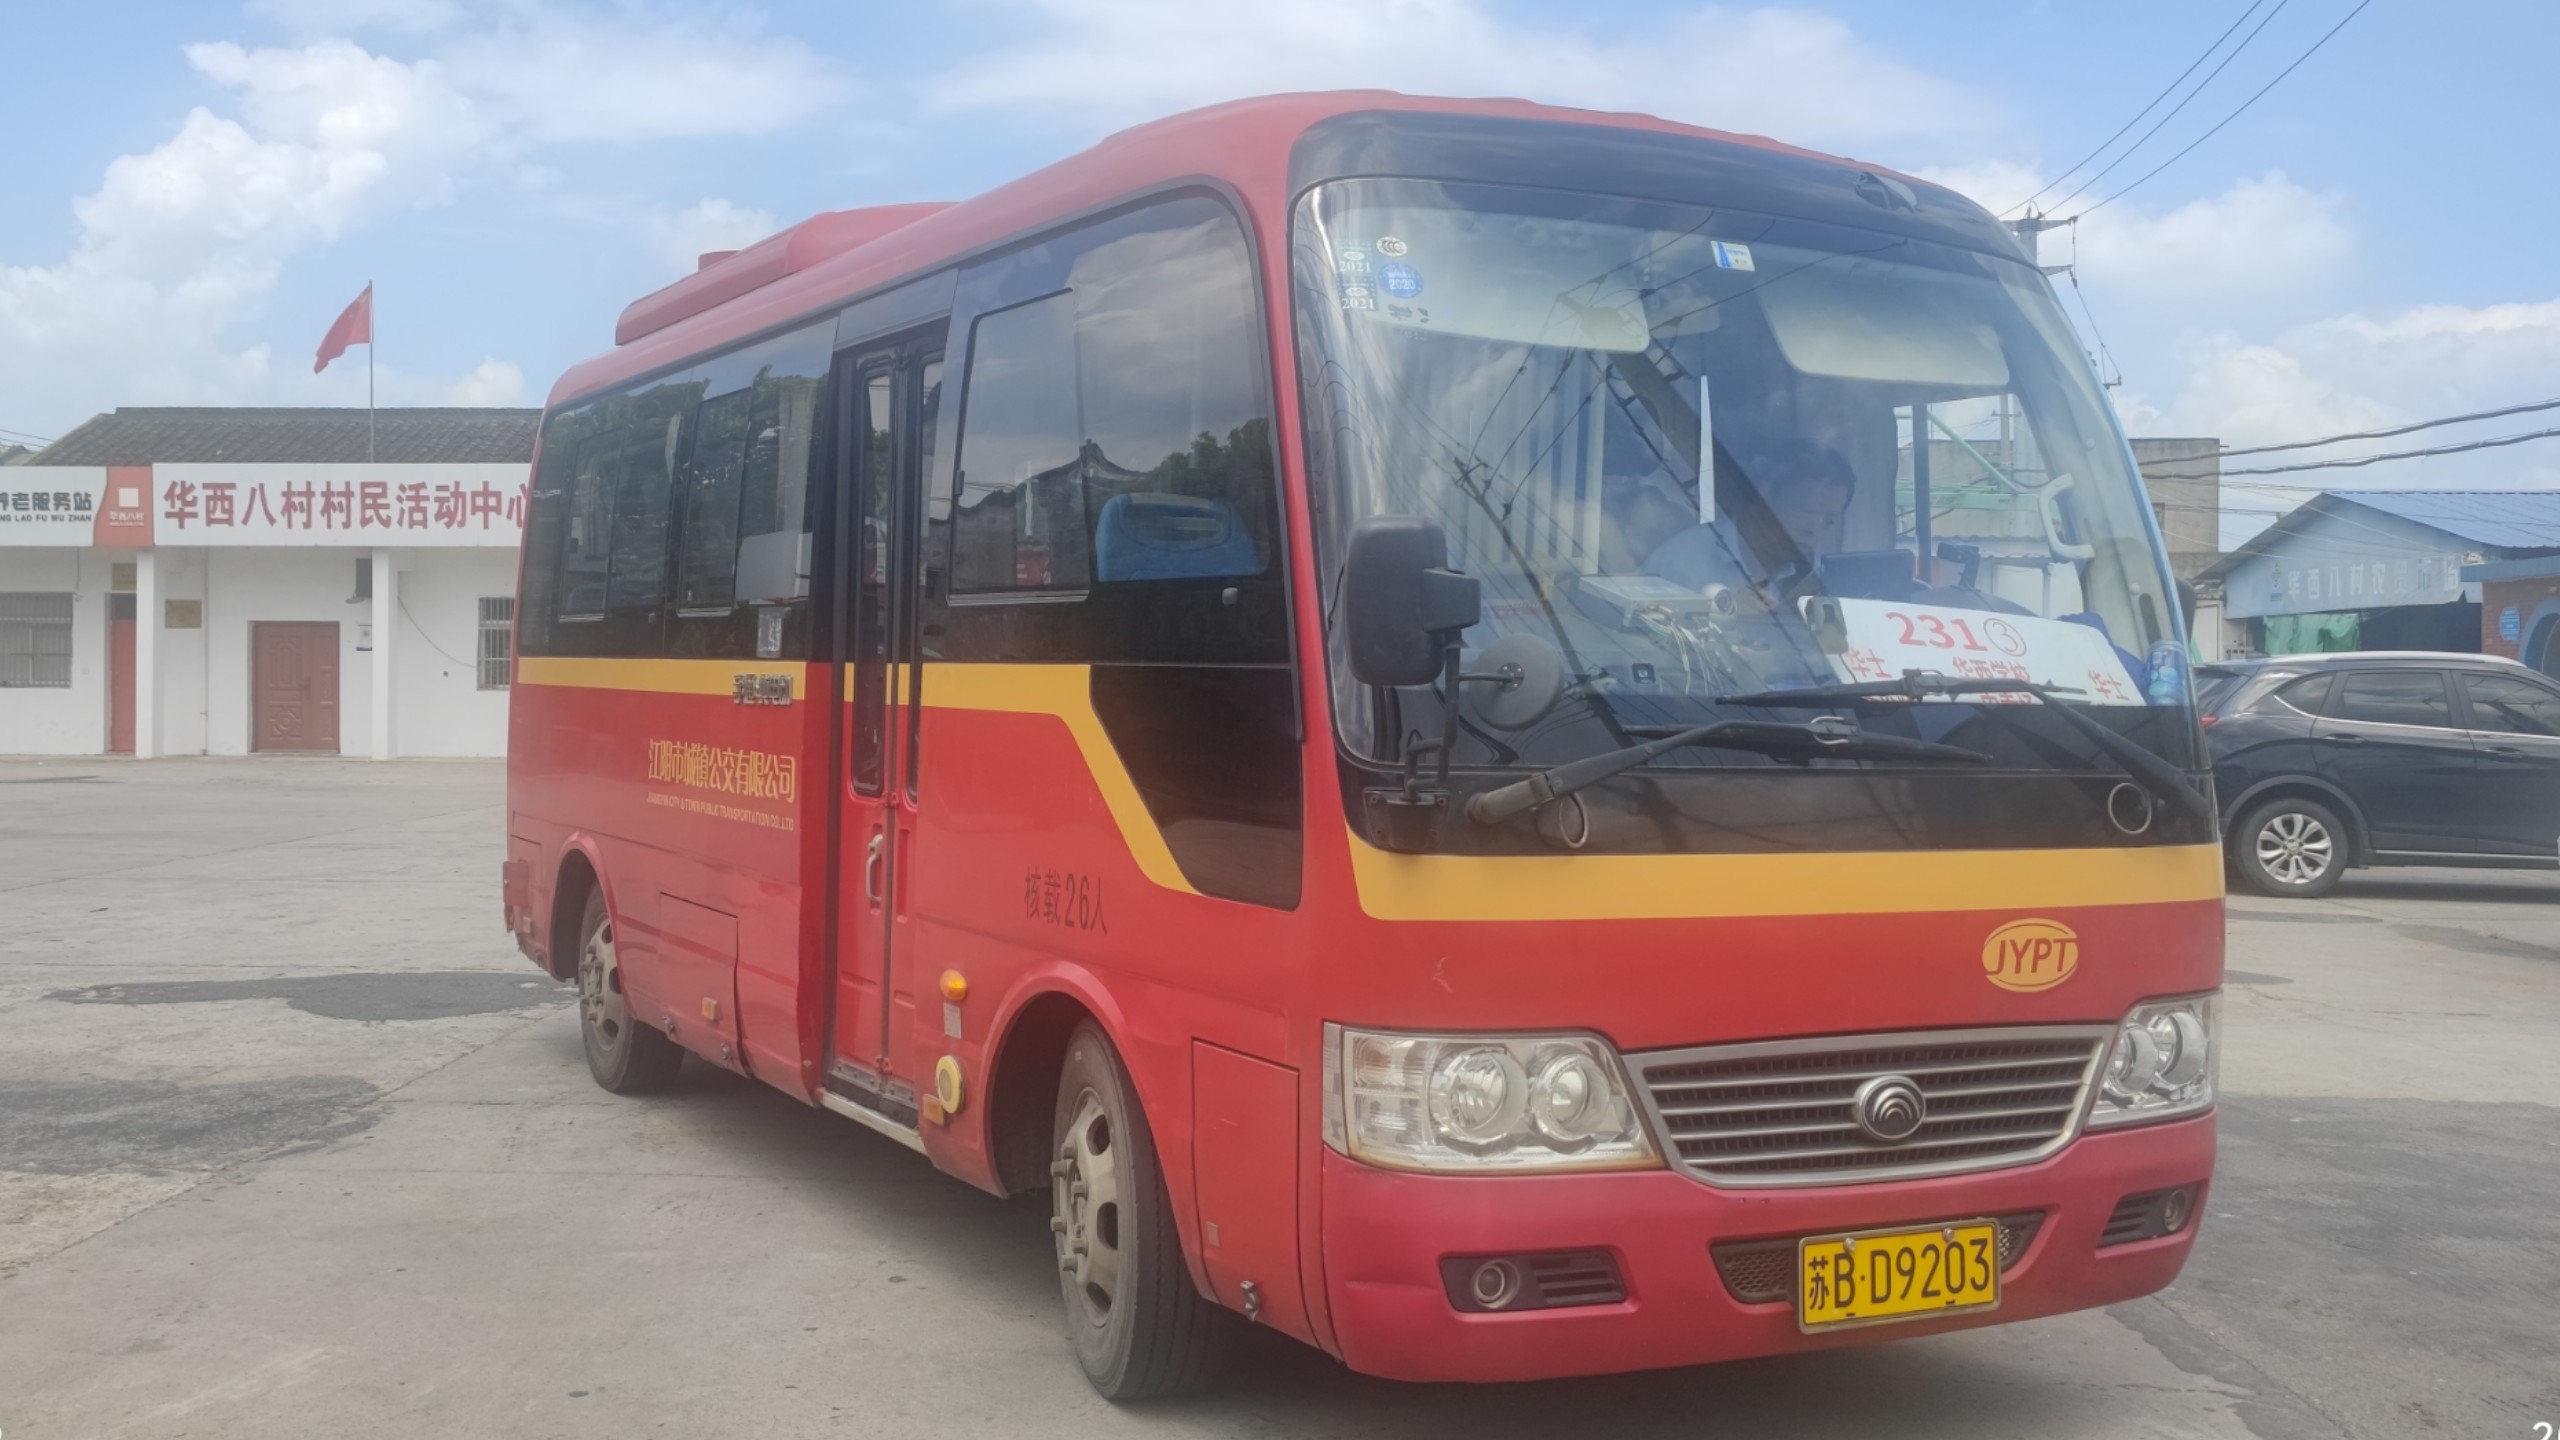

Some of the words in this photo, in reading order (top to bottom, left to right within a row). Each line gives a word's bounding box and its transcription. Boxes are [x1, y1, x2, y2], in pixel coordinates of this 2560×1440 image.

[1340, 261, 1371, 272] 2021
[1389, 279, 1415, 290] 2020
[1342, 298, 1374, 309] 2021
[15, 514, 32, 522] LAO
[36, 514, 48, 522] FU
[51, 514, 65, 522] WU
[69, 514, 92, 522] ZHAN
[1885, 612, 1988, 652] 231
[1024, 866, 1107, 935] 核载26人
[1987, 938, 2078, 975] JYPT
